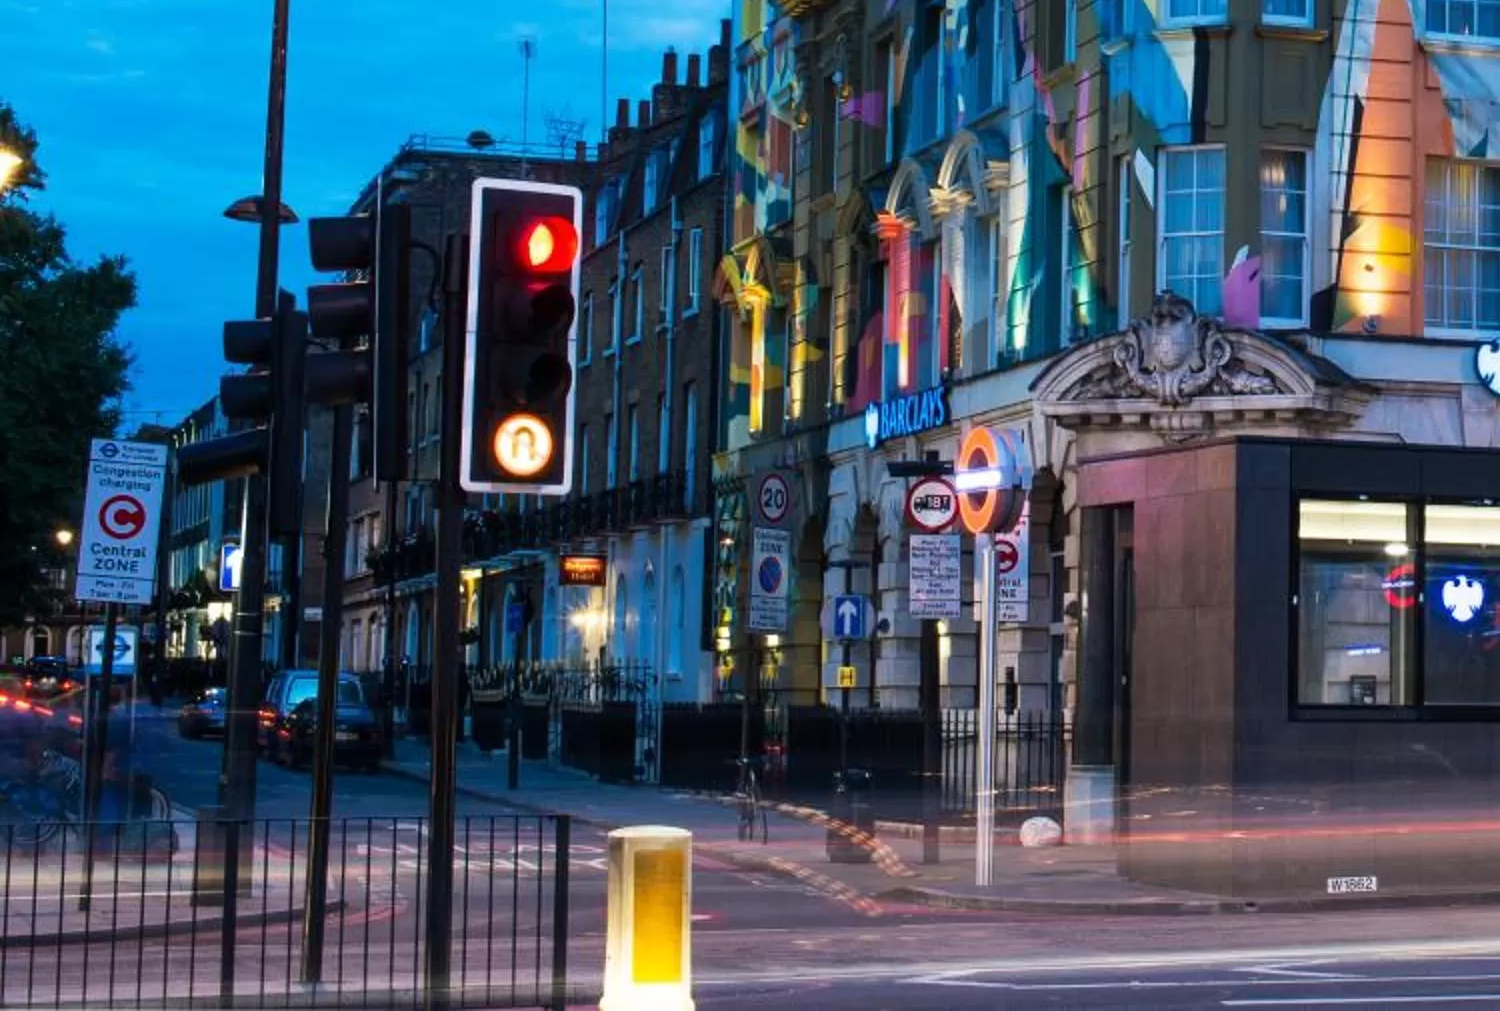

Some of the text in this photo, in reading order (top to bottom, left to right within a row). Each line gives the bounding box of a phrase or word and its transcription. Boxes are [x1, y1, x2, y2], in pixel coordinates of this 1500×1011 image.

[881, 386, 945, 439] BARCLAYS
[92, 464, 161, 479] Congestion
[99, 476, 152, 492] charging
[763, 488, 785, 509] 20
[90, 542, 147, 558] Central
[93, 557, 140, 574] ZONE
